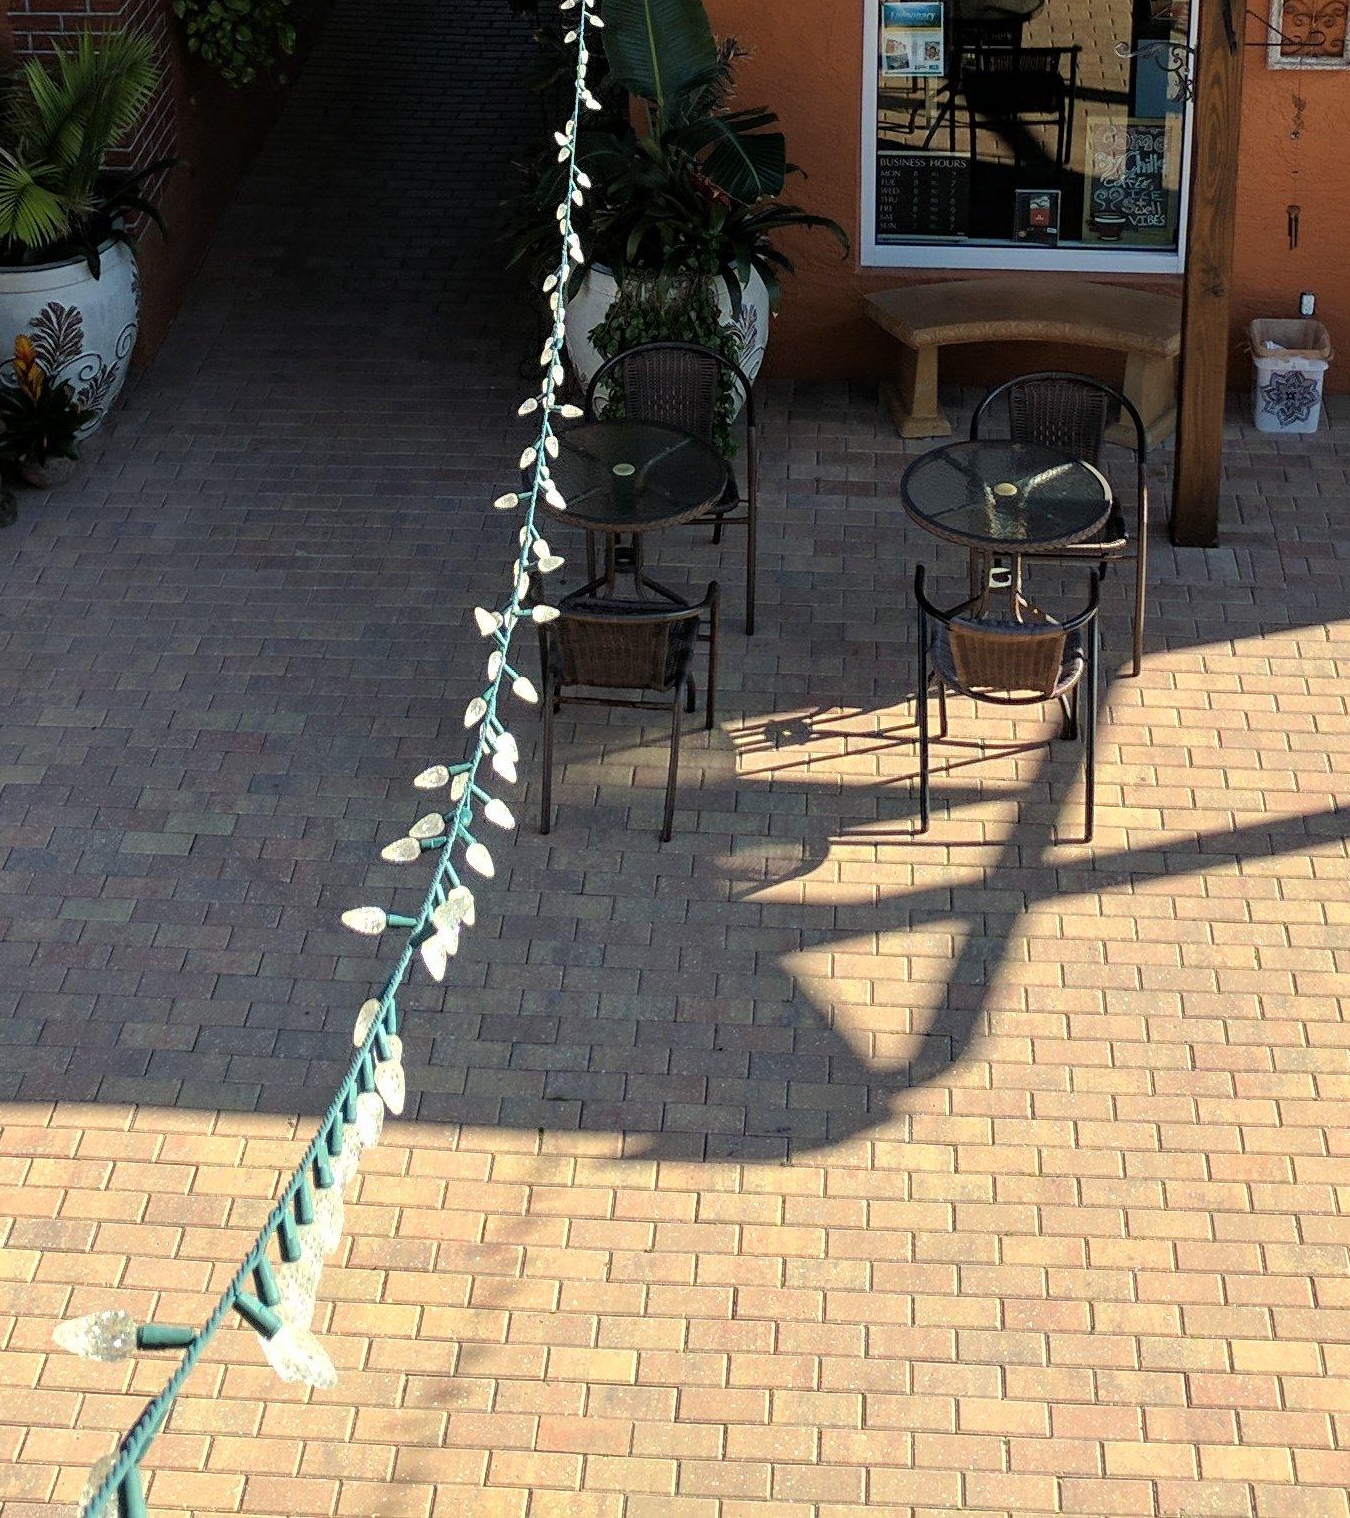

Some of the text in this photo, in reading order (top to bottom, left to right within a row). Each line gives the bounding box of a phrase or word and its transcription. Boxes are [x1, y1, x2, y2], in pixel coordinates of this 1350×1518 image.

[879, 157, 967, 168] BUSINESS HOURS
[1128, 215, 1166, 226] VIBES
